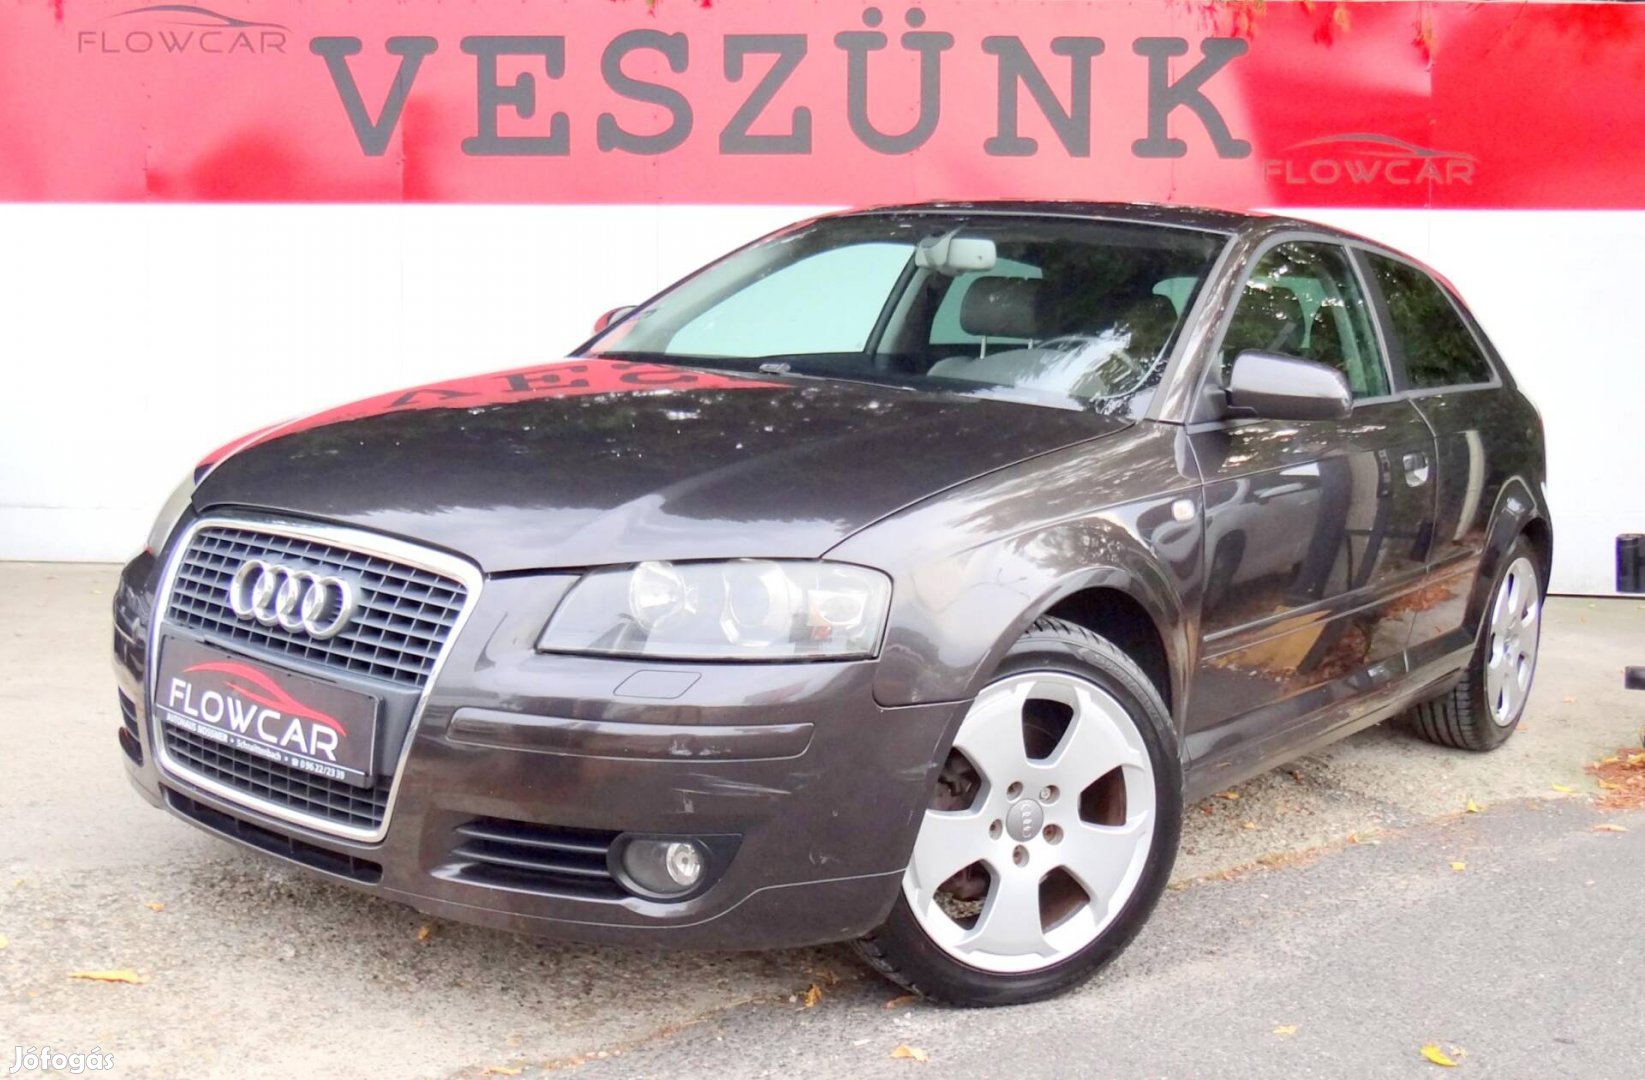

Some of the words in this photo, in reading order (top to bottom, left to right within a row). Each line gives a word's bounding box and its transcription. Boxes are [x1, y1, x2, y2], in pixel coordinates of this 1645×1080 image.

[77, 30, 287, 54] FLOWCAR
[309, 6, 1253, 159] VESZÜNK
[1264, 158, 1476, 185] FLOWCAR
[168, 677, 339, 761] FLOWCAR
